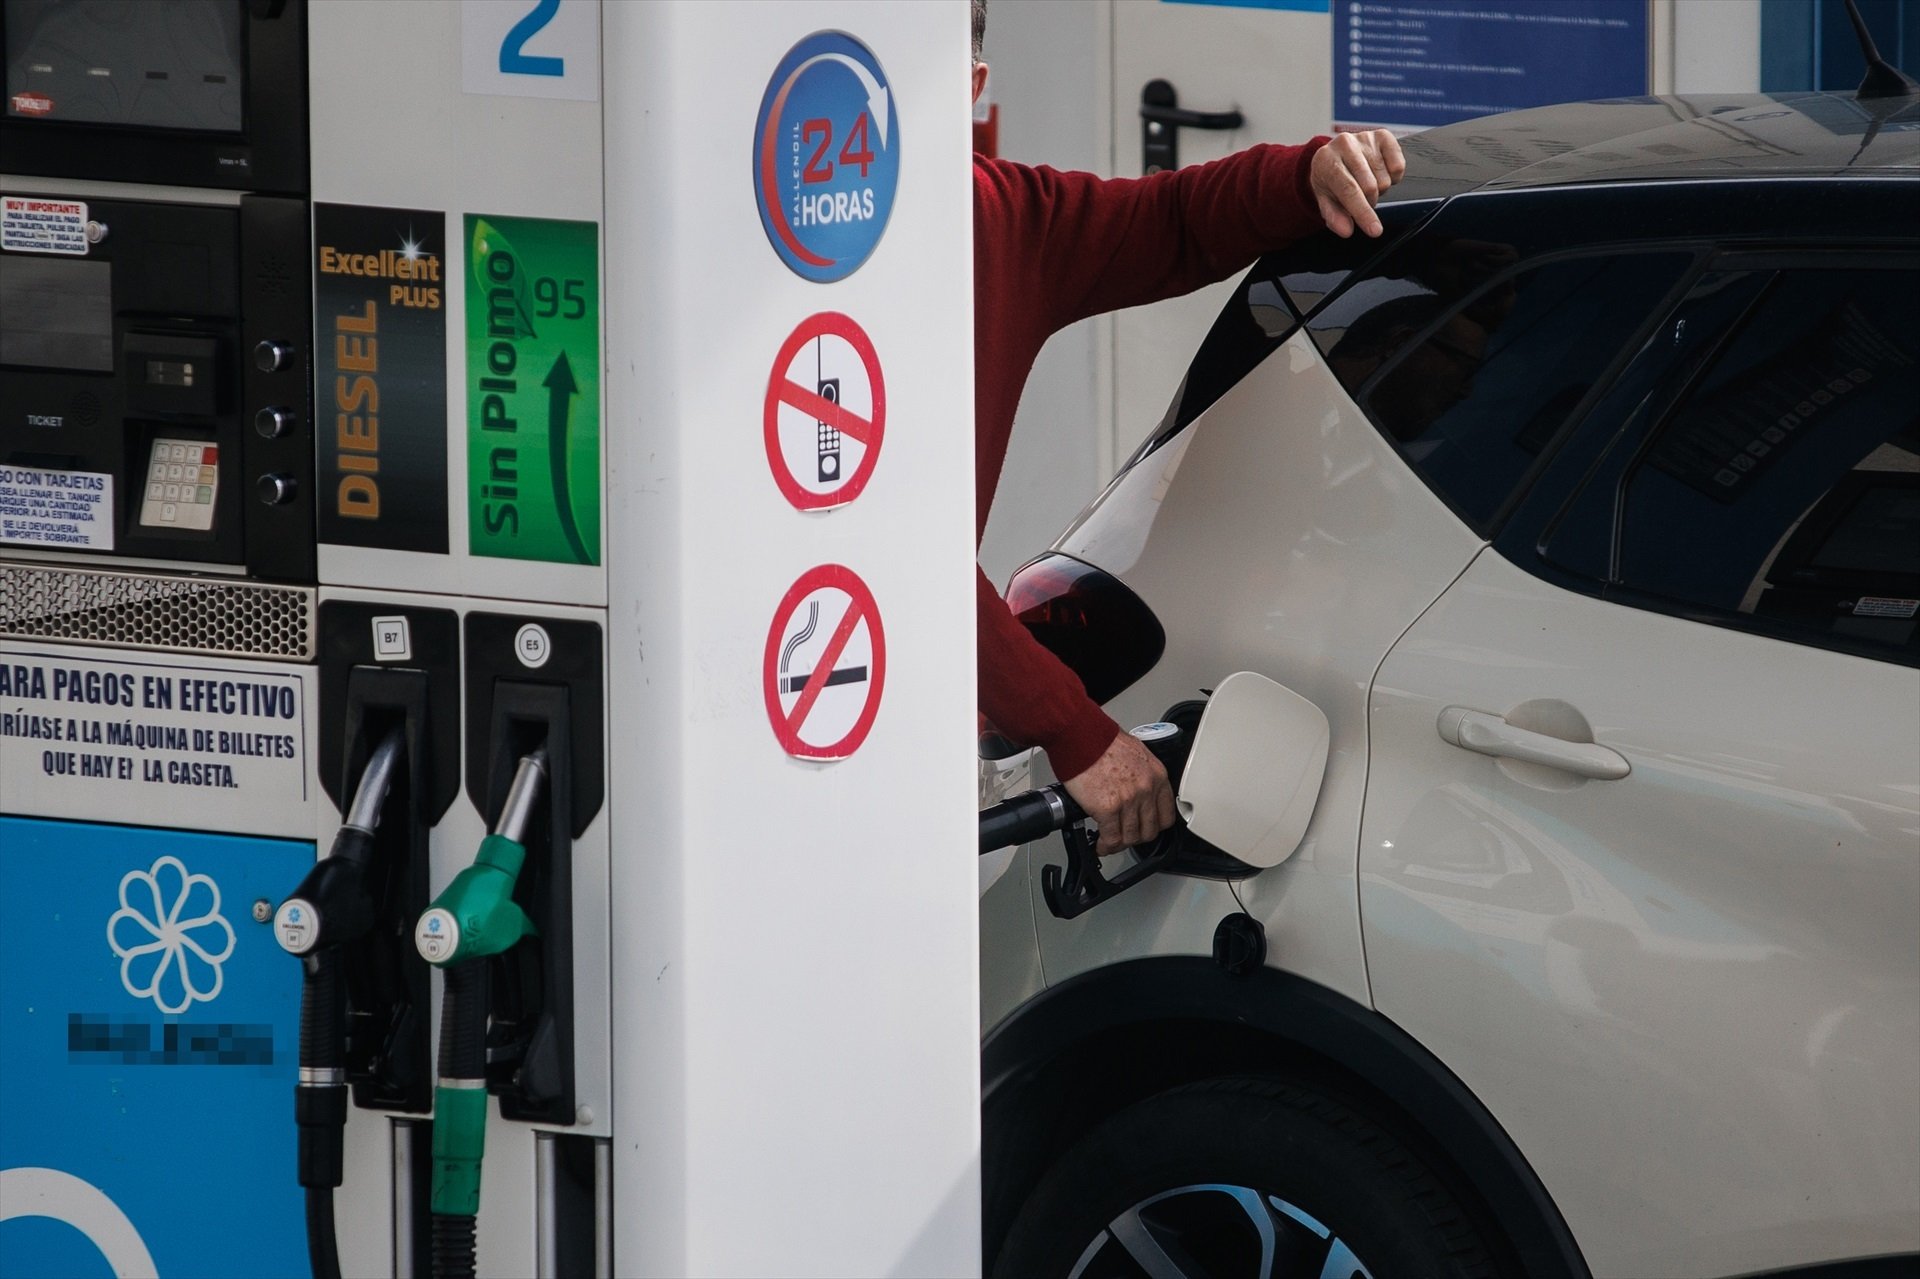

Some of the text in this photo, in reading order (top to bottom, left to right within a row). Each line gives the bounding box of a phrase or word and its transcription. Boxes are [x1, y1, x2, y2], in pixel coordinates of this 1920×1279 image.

[500, 0, 564, 77] 2
[803, 111, 875, 185] 24
[6, 201, 80, 214] MUY IMPORTANTE
[802, 187, 875, 226] HORAS
[320, 246, 440, 283] Excellent
[389, 284, 440, 309] PLUS
[533, 276, 586, 320] 95
[479, 250, 519, 537] Sin Plomo
[27, 414, 64, 427] TICKET
[335, 300, 380, 520] DIESEL
[15, 471, 42, 485] CON
[44, 473, 104, 490] TARJETAS
[20, 489, 53, 499] LLENAR
[54, 491, 65, 500] EL
[67, 492, 101, 503] TANQUE
[28, 498, 46, 508] UNA
[48, 500, 91, 511] CANTIDAD
[3, 520, 14, 529] SE
[15, 521, 27, 530] LE
[31, 509, 38, 517] A
[39, 509, 50, 518] LA
[51, 510, 95, 521] ESTIMADA
[5, 530, 90, 544] IMPORTE SOBRANTE
[384, 633, 398, 643] B7
[526, 640, 539, 650] E5
[53, 668, 135, 707] PAGOS
[142, 676, 172, 709] EN
[179, 679, 295, 719] EFECTIVO
[0, 707, 295, 759] RÍJASE A LA MÁQUINA DE BILLETES
[43, 751, 76, 777] QUE
[80, 754, 114, 779] HAY
[143, 758, 164, 782] LA
[167, 761, 239, 788] CASETA.
